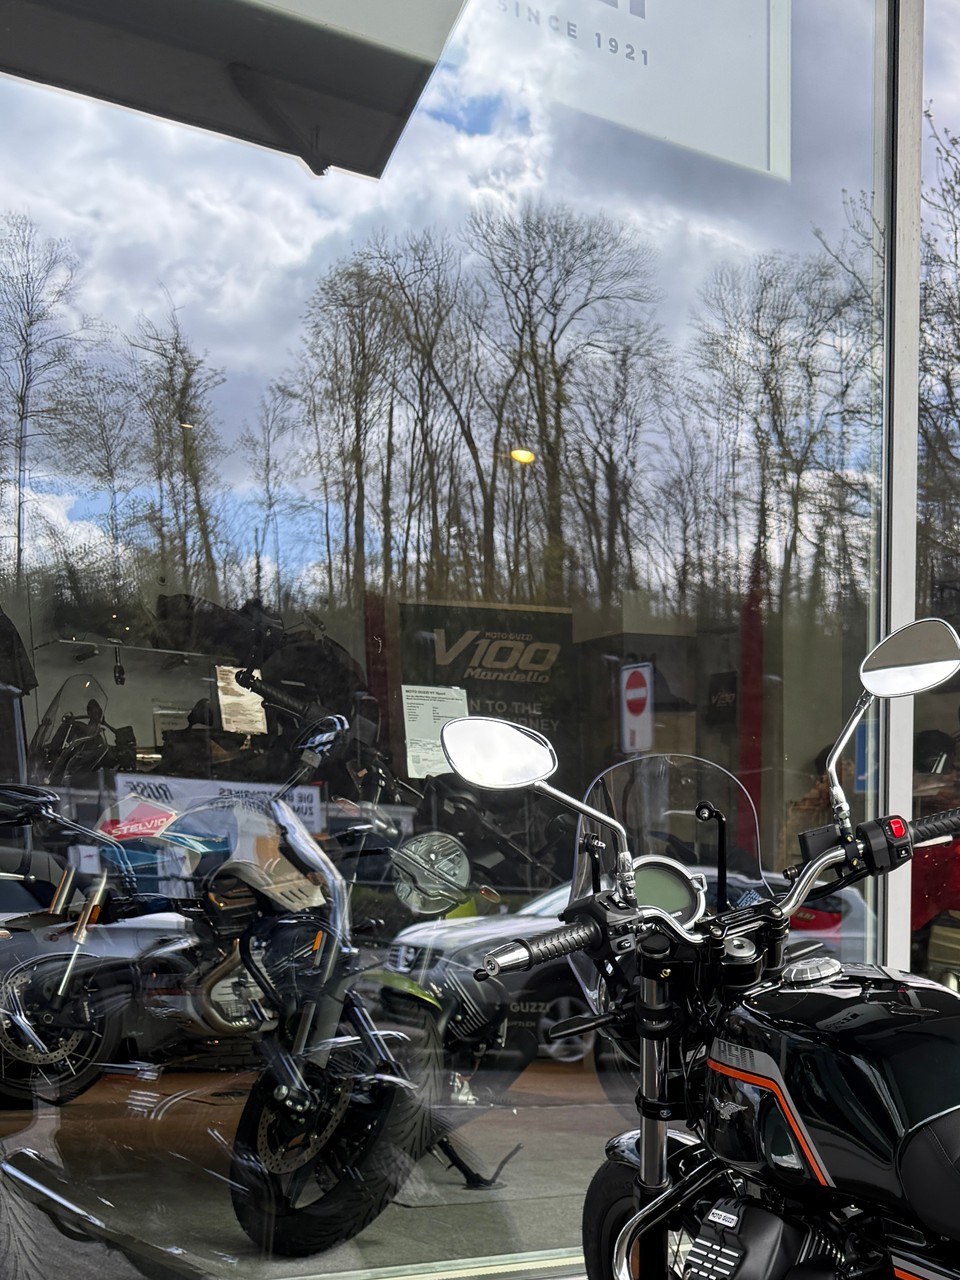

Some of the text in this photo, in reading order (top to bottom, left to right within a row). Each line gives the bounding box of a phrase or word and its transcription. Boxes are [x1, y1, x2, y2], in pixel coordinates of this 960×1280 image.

[497, 0, 577, 39] SINCE
[595, 32, 648, 66] 1921
[433, 628, 560, 671] V100
[463, 668, 550, 683] Mandello
[486, 701, 507, 713] TO
[512, 702, 542, 715] THE
[112, 818, 167, 836] STELVIO
[510, 1002, 550, 1013] GUZZI
